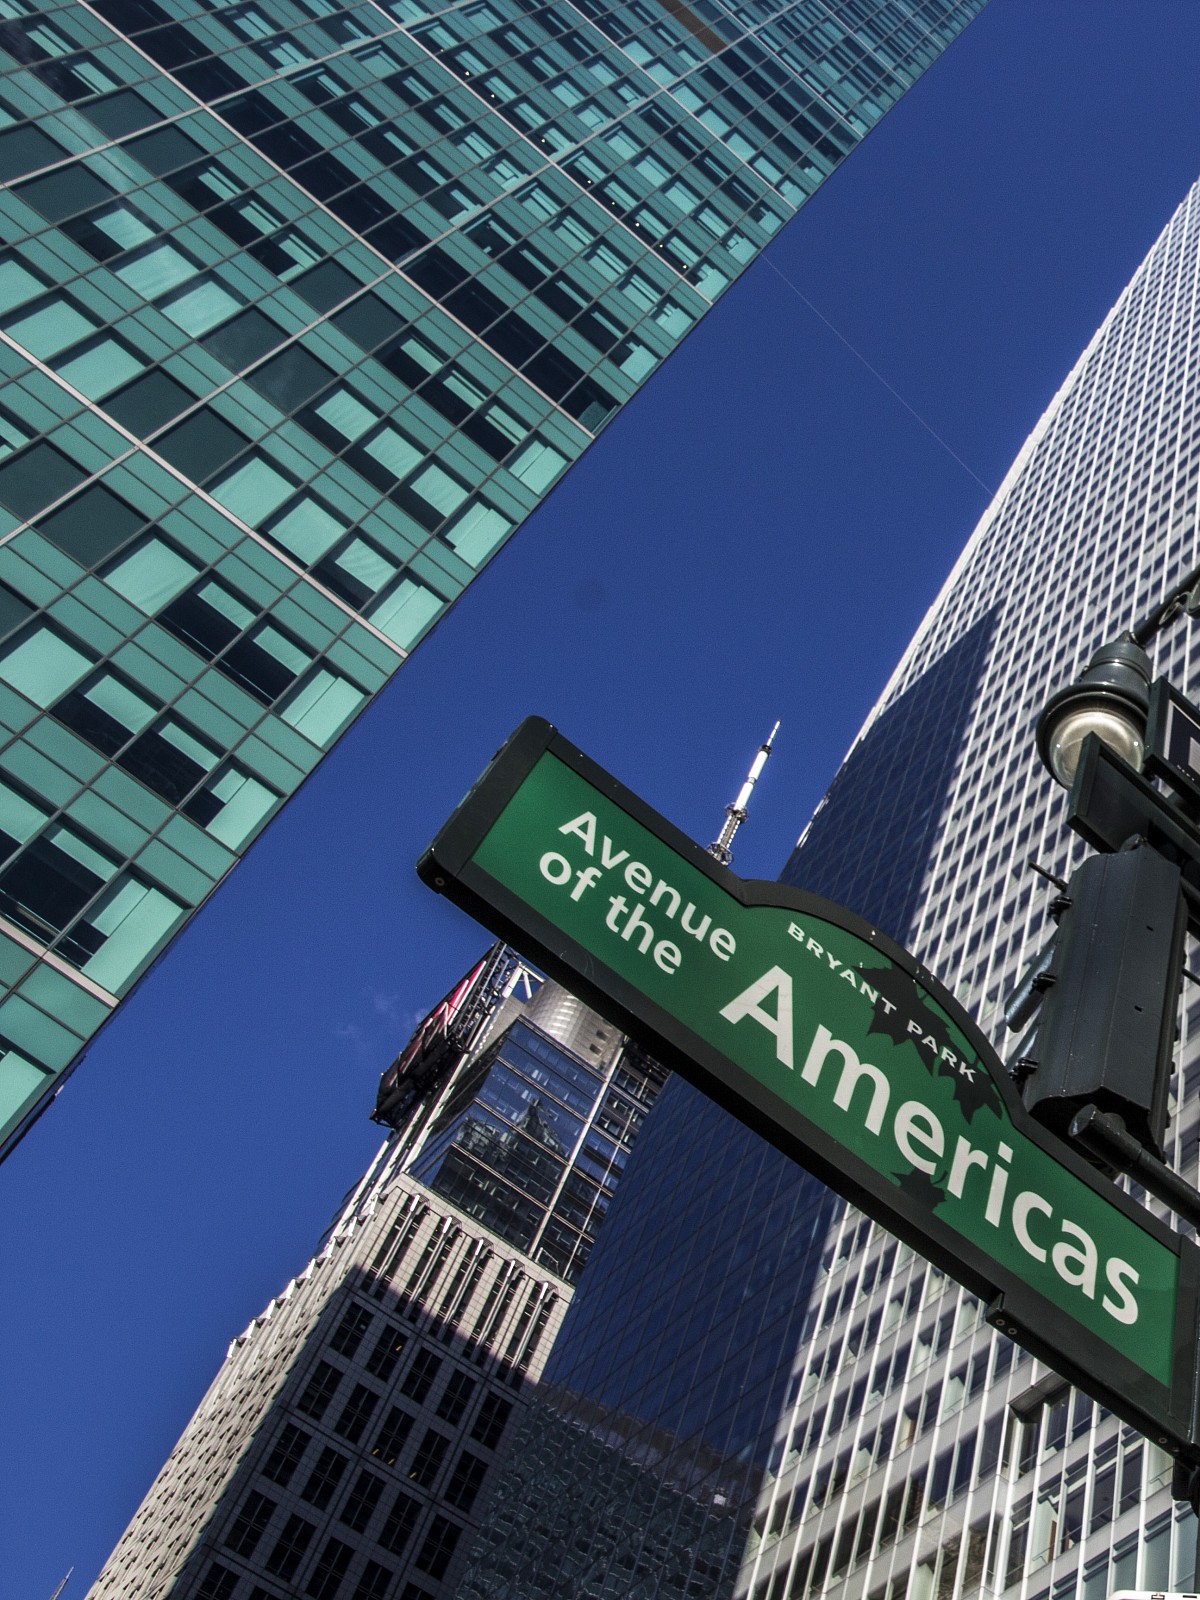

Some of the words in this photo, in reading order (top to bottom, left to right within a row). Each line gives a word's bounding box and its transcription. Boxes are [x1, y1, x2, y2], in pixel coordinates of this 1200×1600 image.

[538, 851, 603, 902] of
[605, 895, 682, 975] the
[558, 811, 737, 962] Avenue
[786, 921, 898, 1016] BRYANT
[906, 1019, 977, 1084] PARK
[718, 964, 1140, 1325] Americas
